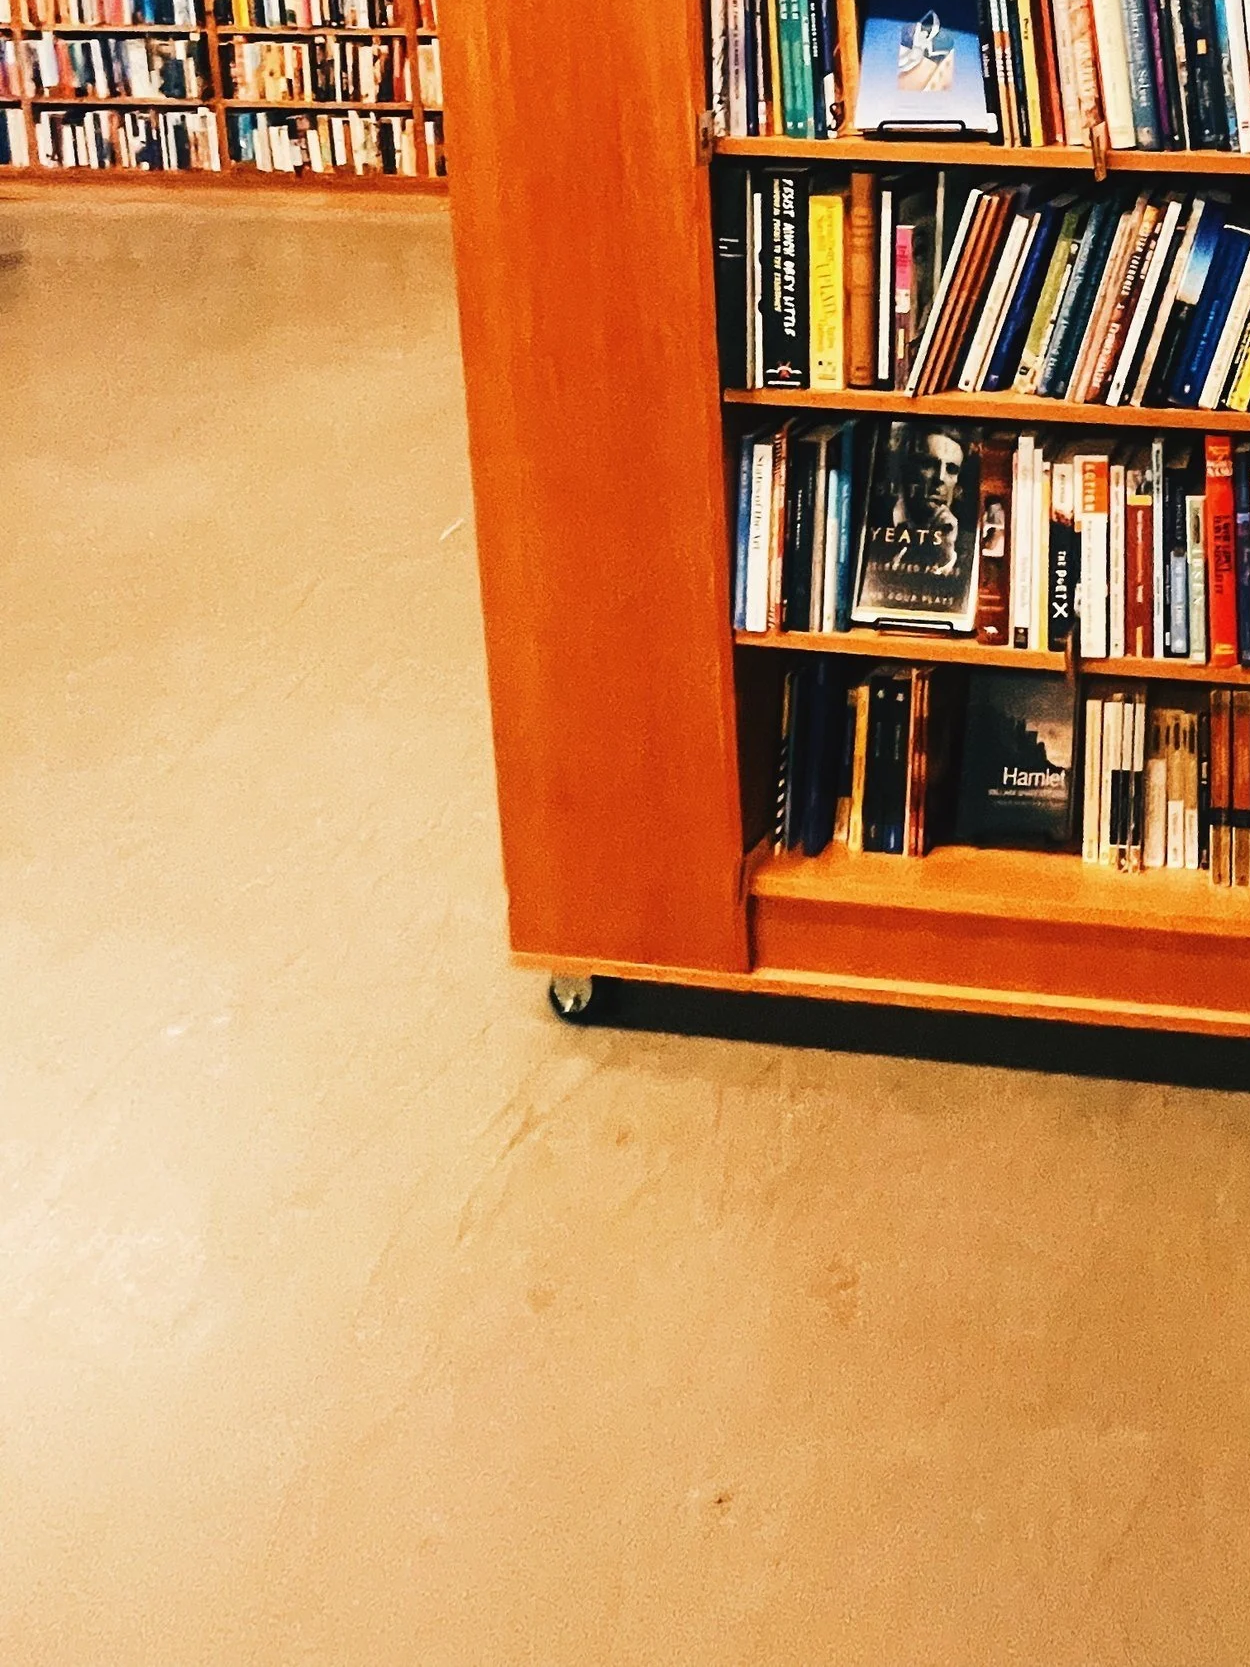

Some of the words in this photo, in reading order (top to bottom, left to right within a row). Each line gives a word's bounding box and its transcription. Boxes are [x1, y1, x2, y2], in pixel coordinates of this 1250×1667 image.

[782, 178, 795, 217] RESIST
[783, 296, 795, 337] LITTLE
[871, 526, 943, 547] YEATS
[1057, 551, 1066, 566] THE
[1055, 570, 1066, 600] POET
[1052, 602, 1068, 619] X
[1002, 766, 1067, 787] Hamlet
